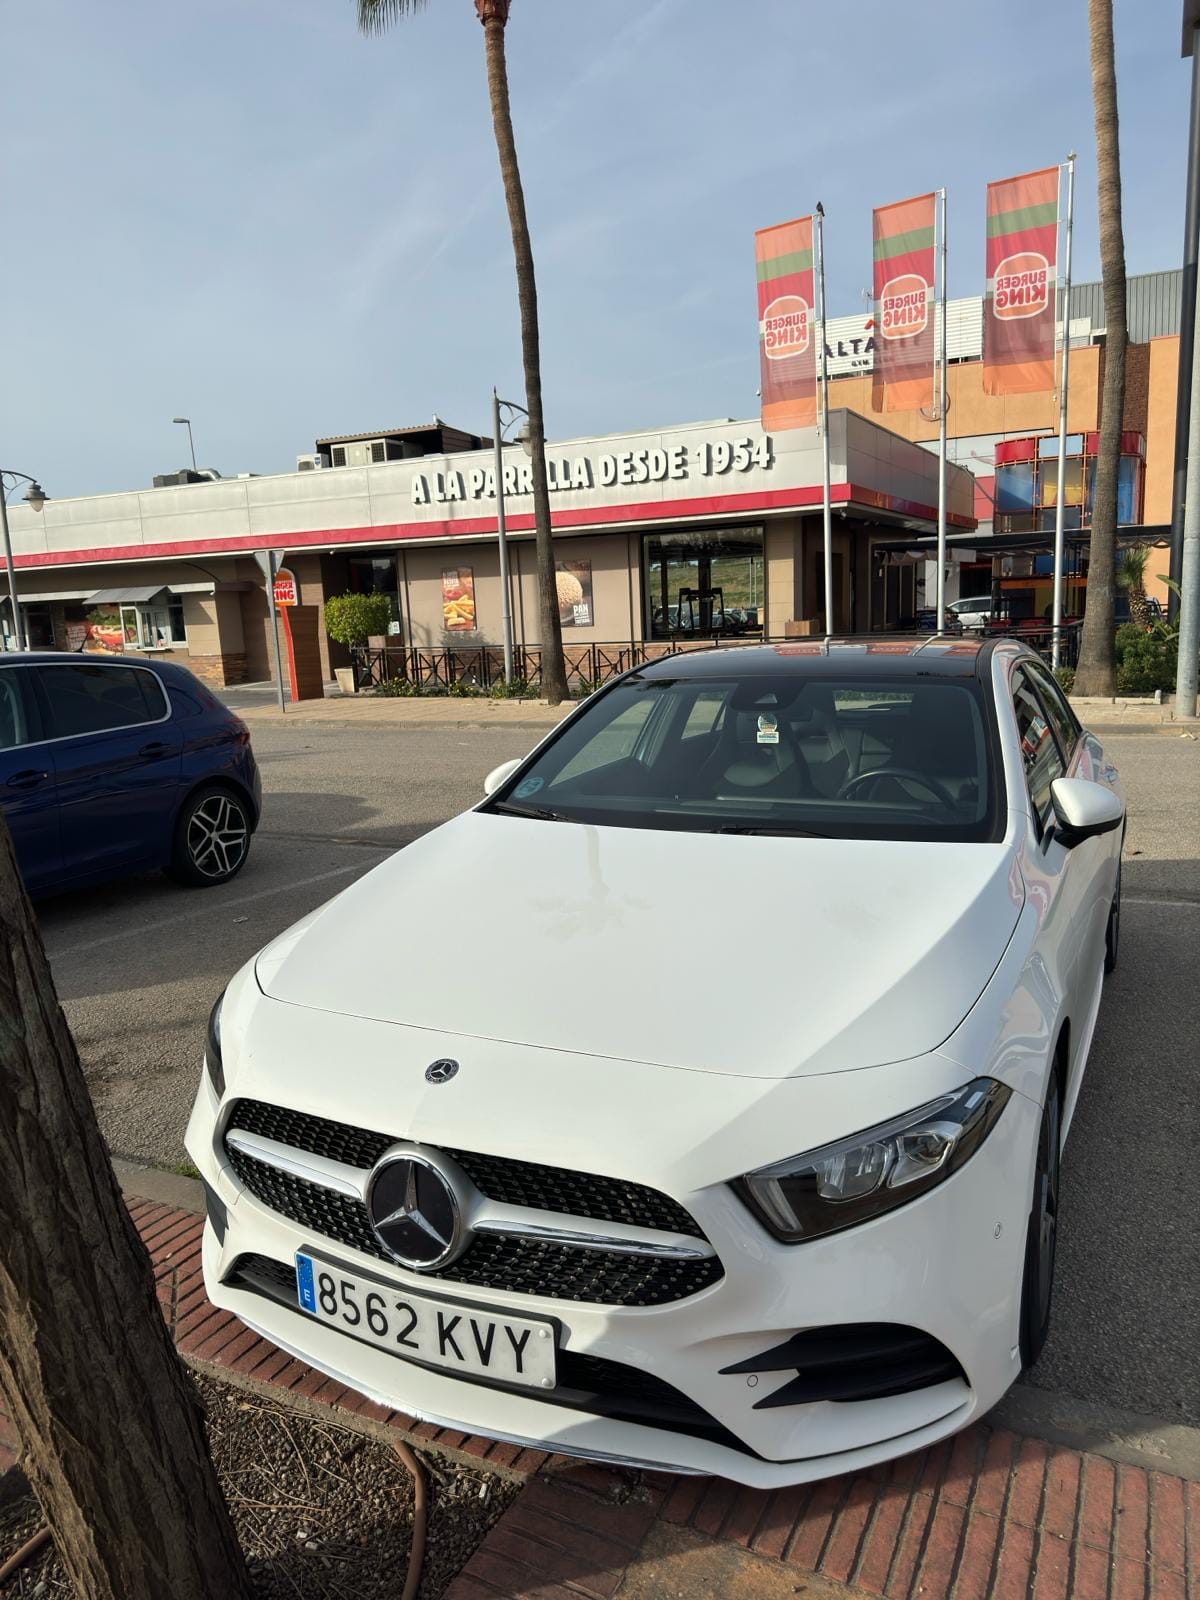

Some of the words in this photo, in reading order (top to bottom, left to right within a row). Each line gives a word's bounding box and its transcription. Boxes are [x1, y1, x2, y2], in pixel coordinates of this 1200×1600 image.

[411, 474, 427, 503] A
[433, 471, 463, 501] LA
[469, 457, 591, 499] PARRLLA
[599, 445, 686, 486] DESDE
[695, 436, 773, 475] 1954
[275, 590, 294, 601] ING
[303, 1288, 311, 1302] E
[318, 1272, 419, 1349] 8562
[436, 1311, 531, 1373] KVY
